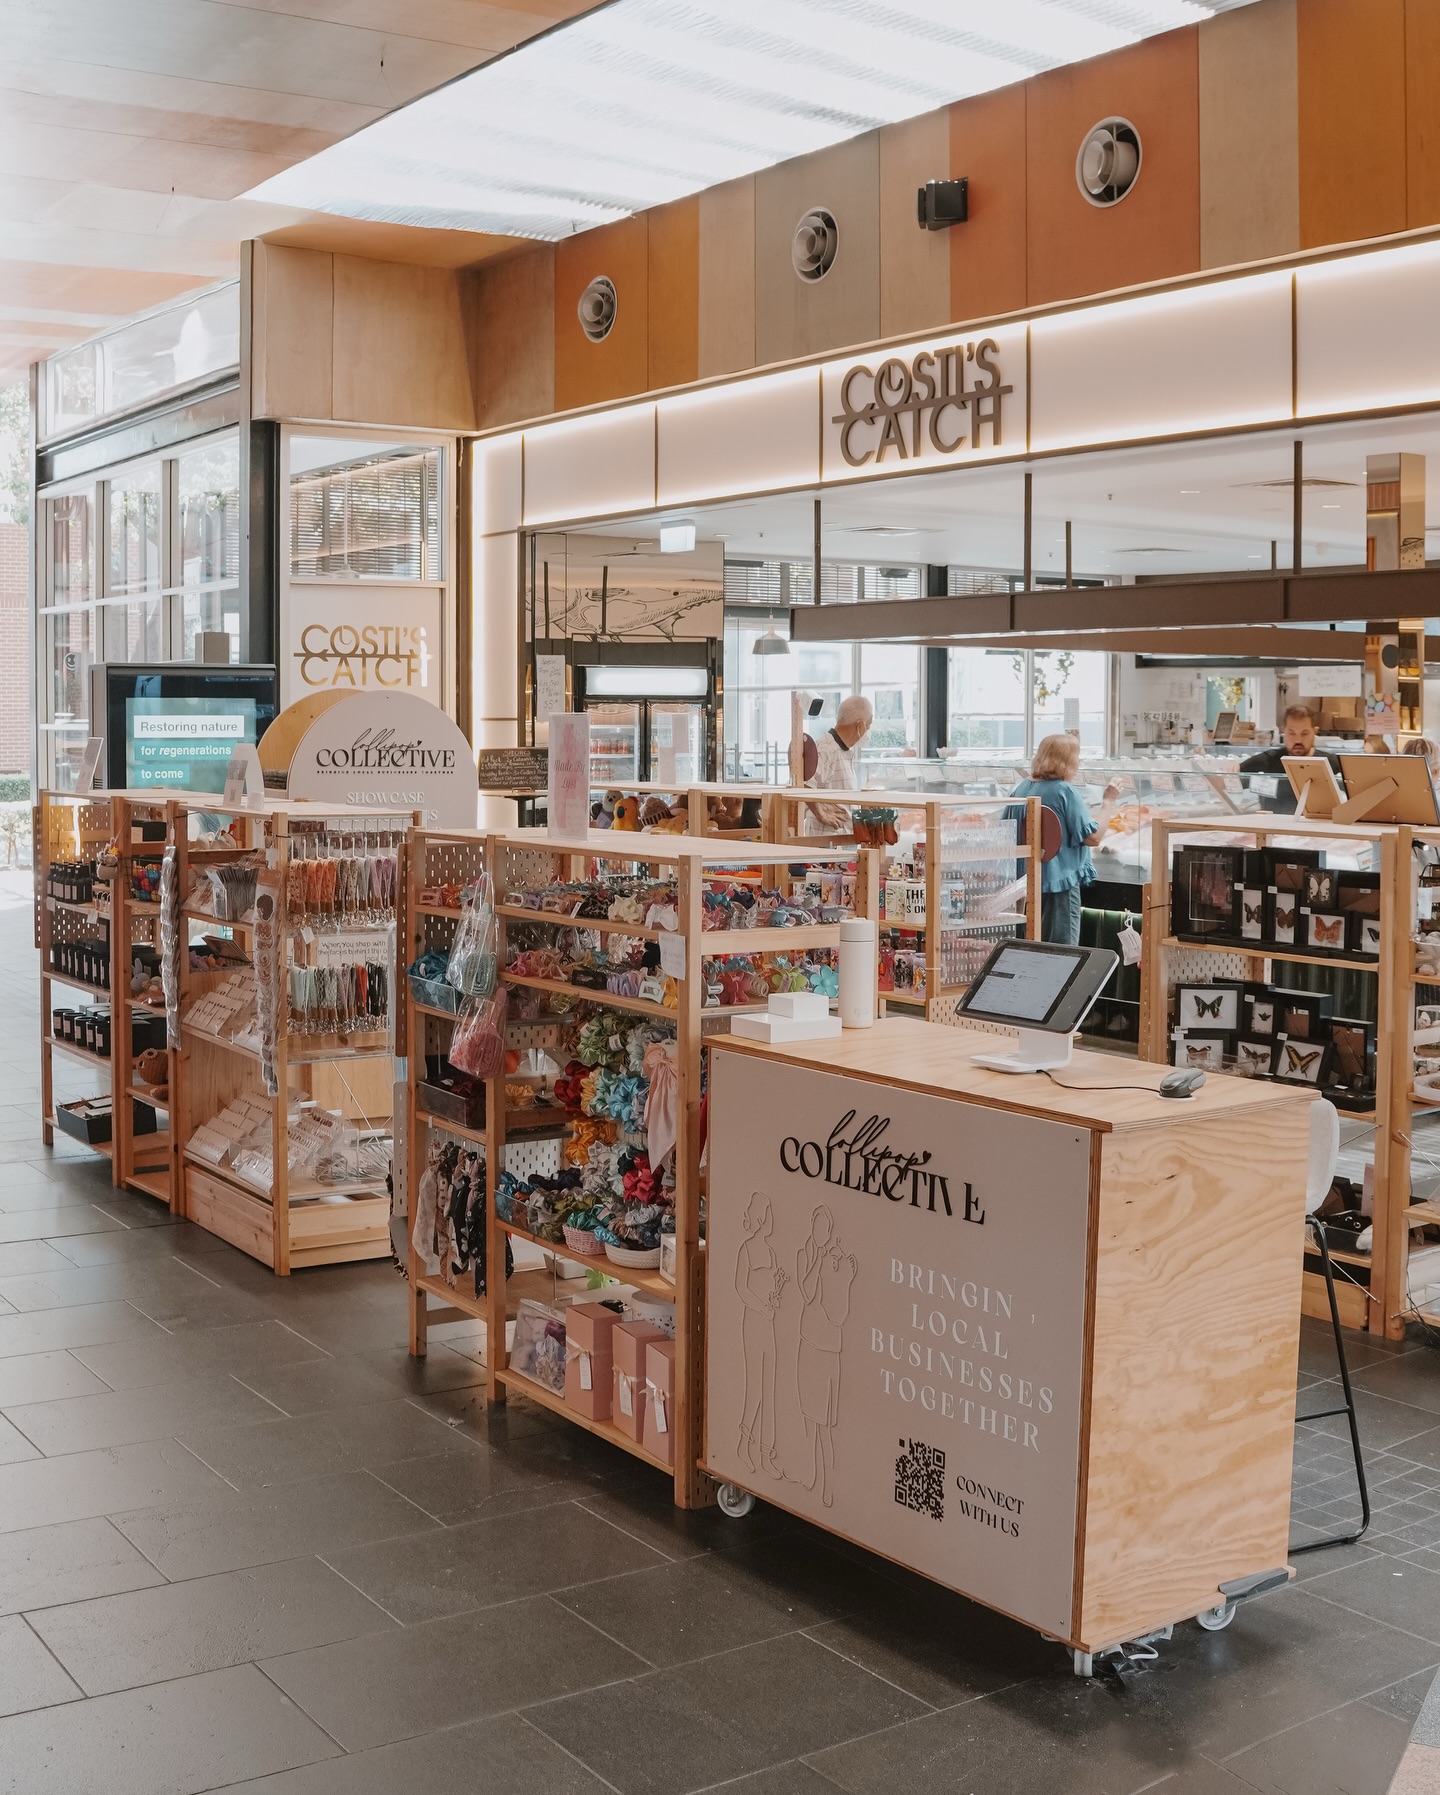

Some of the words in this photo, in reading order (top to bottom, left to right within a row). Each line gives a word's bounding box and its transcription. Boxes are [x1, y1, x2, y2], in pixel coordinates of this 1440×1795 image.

[841, 338, 1000, 414] COSTI'S
[840, 394, 1001, 467] CATCH
[301, 624, 427, 655] COSTI'S
[301, 655, 428, 687] CATCH
[140, 721, 197, 734] Restoring
[201, 722, 238, 732] nature
[141, 746, 157, 756] for
[159, 745, 232, 758] regenerations
[316, 749, 456, 768] COLLECTIVE
[141, 769, 152, 779] to
[154, 769, 184, 779] come
[347, 792, 425, 804] SHOWCASE
[890, 1258, 1035, 1324] BRINGIN
[911, 1303, 1009, 1359] LOCAL
[870, 1327, 1053, 1414] BUSINESSES
[880, 1368, 1040, 1453] TOGETHER
[956, 1475, 1025, 1515] CONNECT
[960, 1500, 997, 1529] WITH
[1001, 1517, 1019, 1538] US
